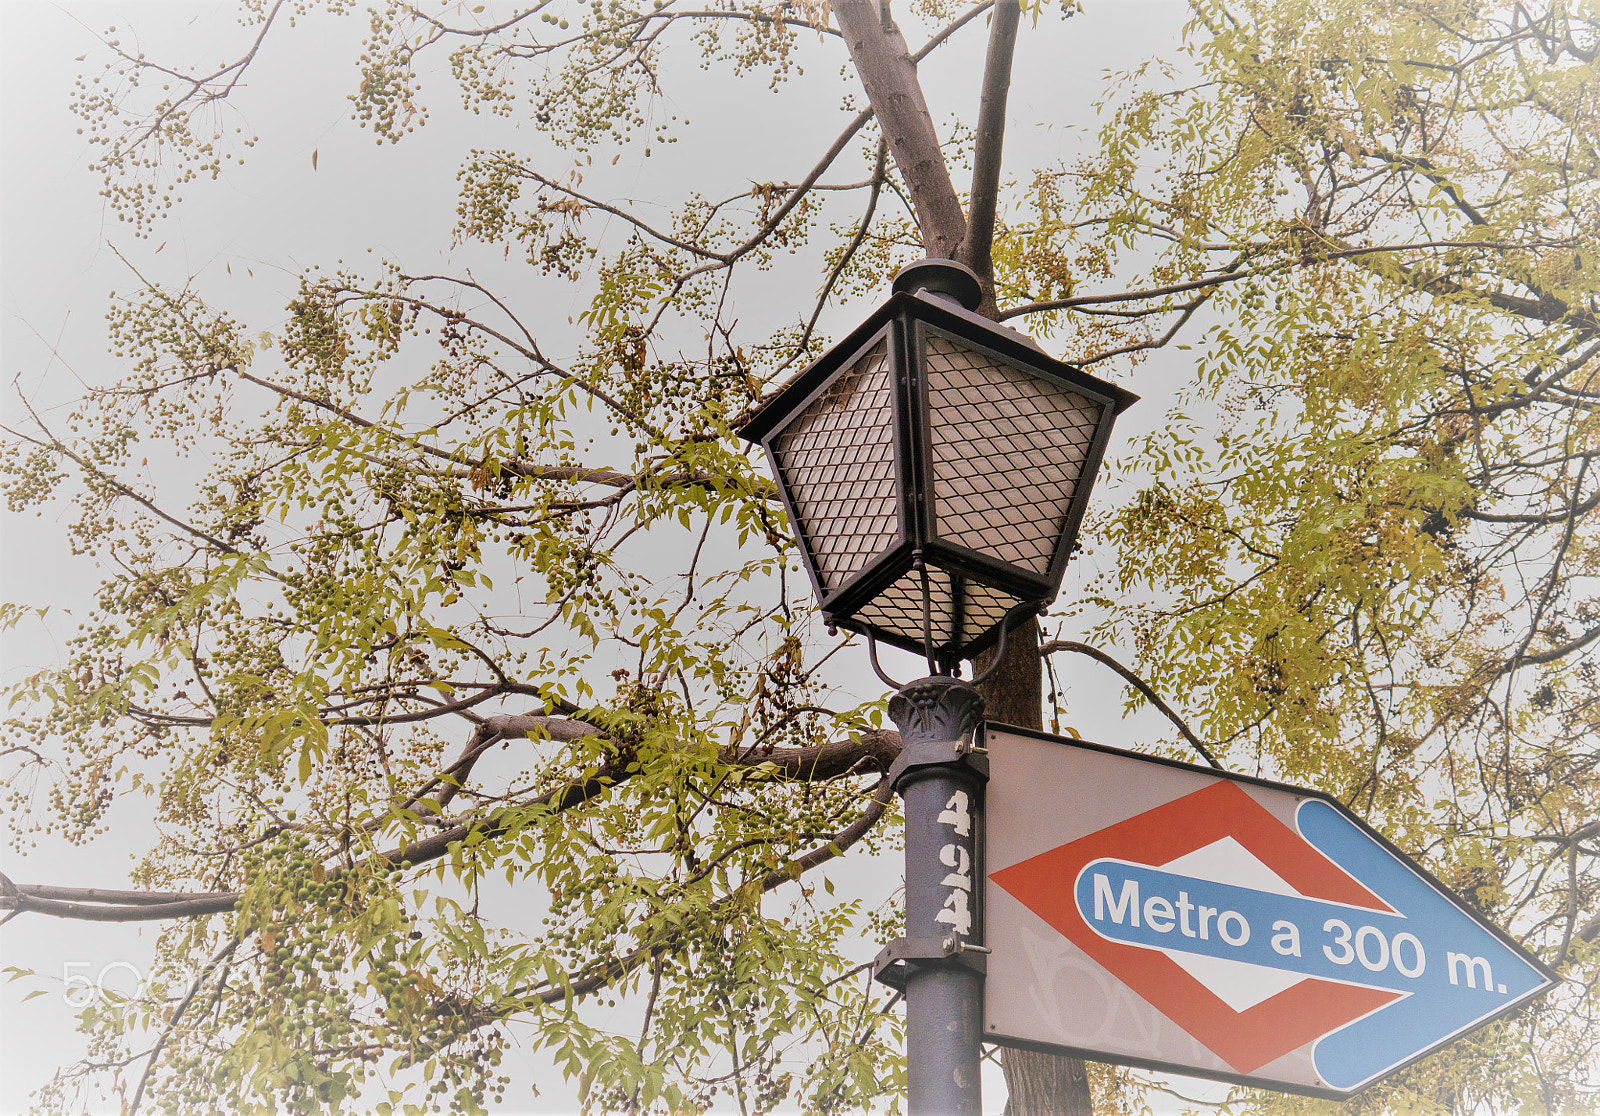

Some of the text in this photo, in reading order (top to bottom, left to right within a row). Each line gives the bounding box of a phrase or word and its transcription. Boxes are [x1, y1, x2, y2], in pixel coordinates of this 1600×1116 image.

[1093, 873, 1508, 994] Metro a 300 m.
